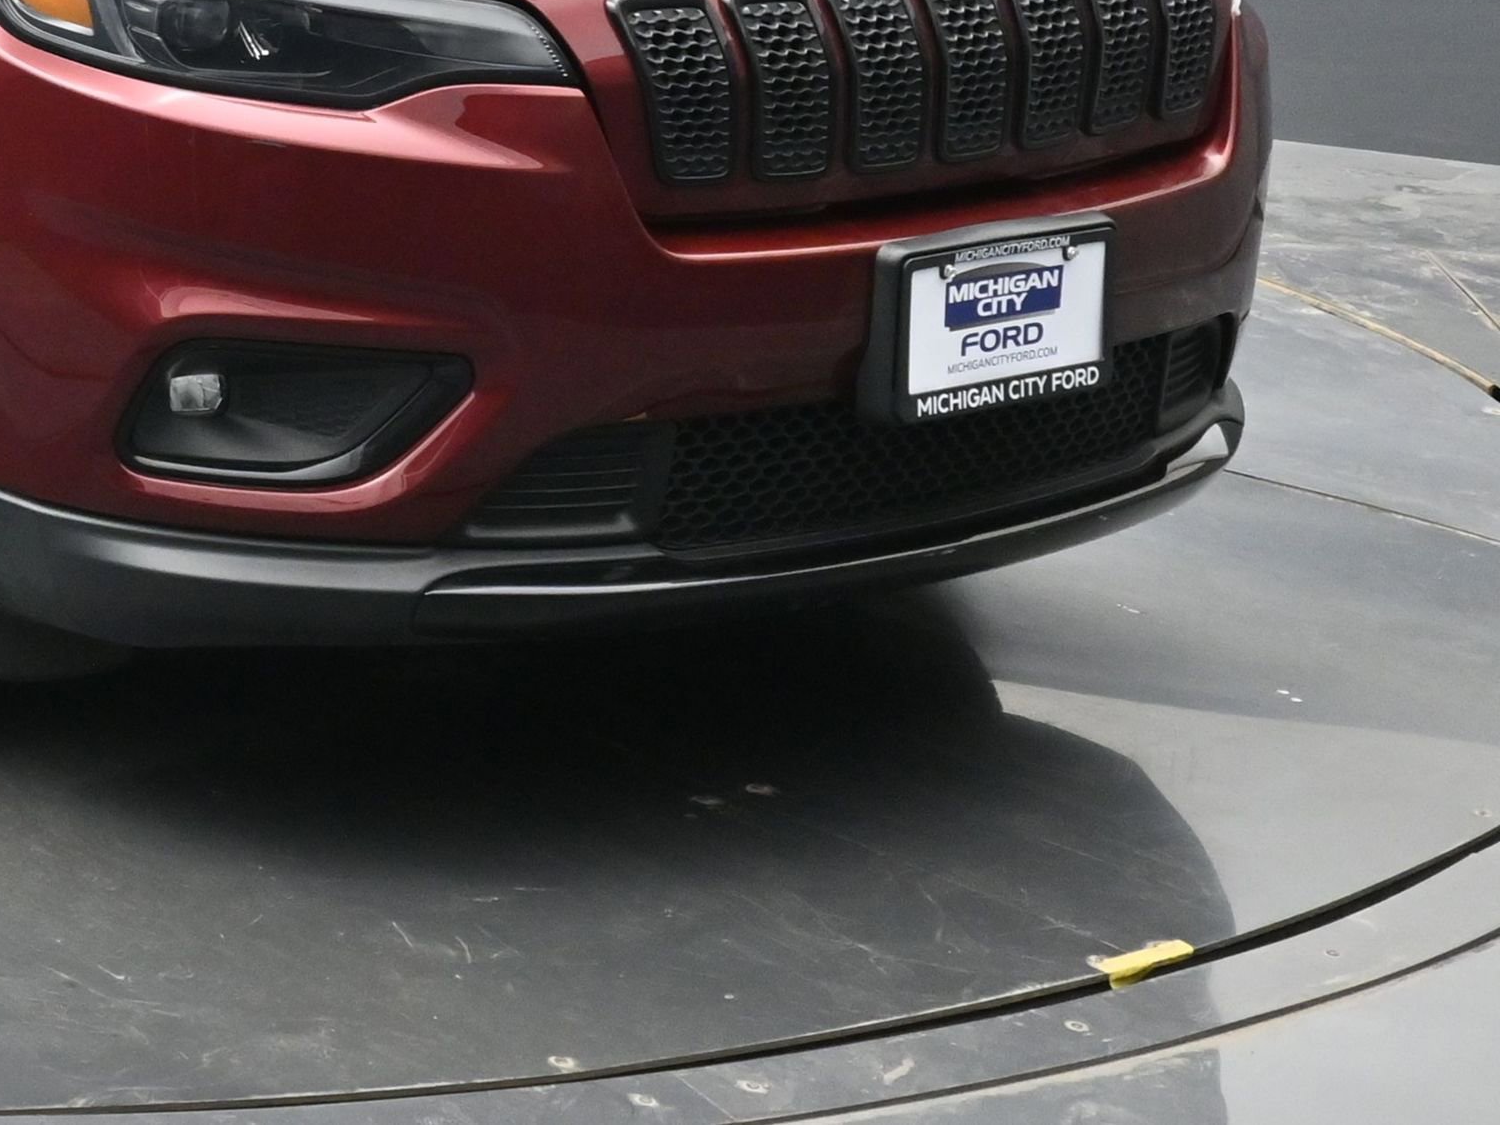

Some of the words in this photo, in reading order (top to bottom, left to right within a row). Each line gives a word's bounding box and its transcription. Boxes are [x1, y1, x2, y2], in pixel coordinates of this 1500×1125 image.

[954, 236, 1071, 263] MICHIGANCITYFORD.COM
[949, 269, 1060, 304] MICHIGAN
[977, 293, 1027, 317] CITY
[961, 322, 1043, 357] FORD
[947, 346, 1058, 374] MICHIGANCITYFORD.COM
[917, 383, 1004, 417] MICHIGAN
[1008, 375, 1047, 400] CITY
[1051, 366, 1099, 392] FORD
